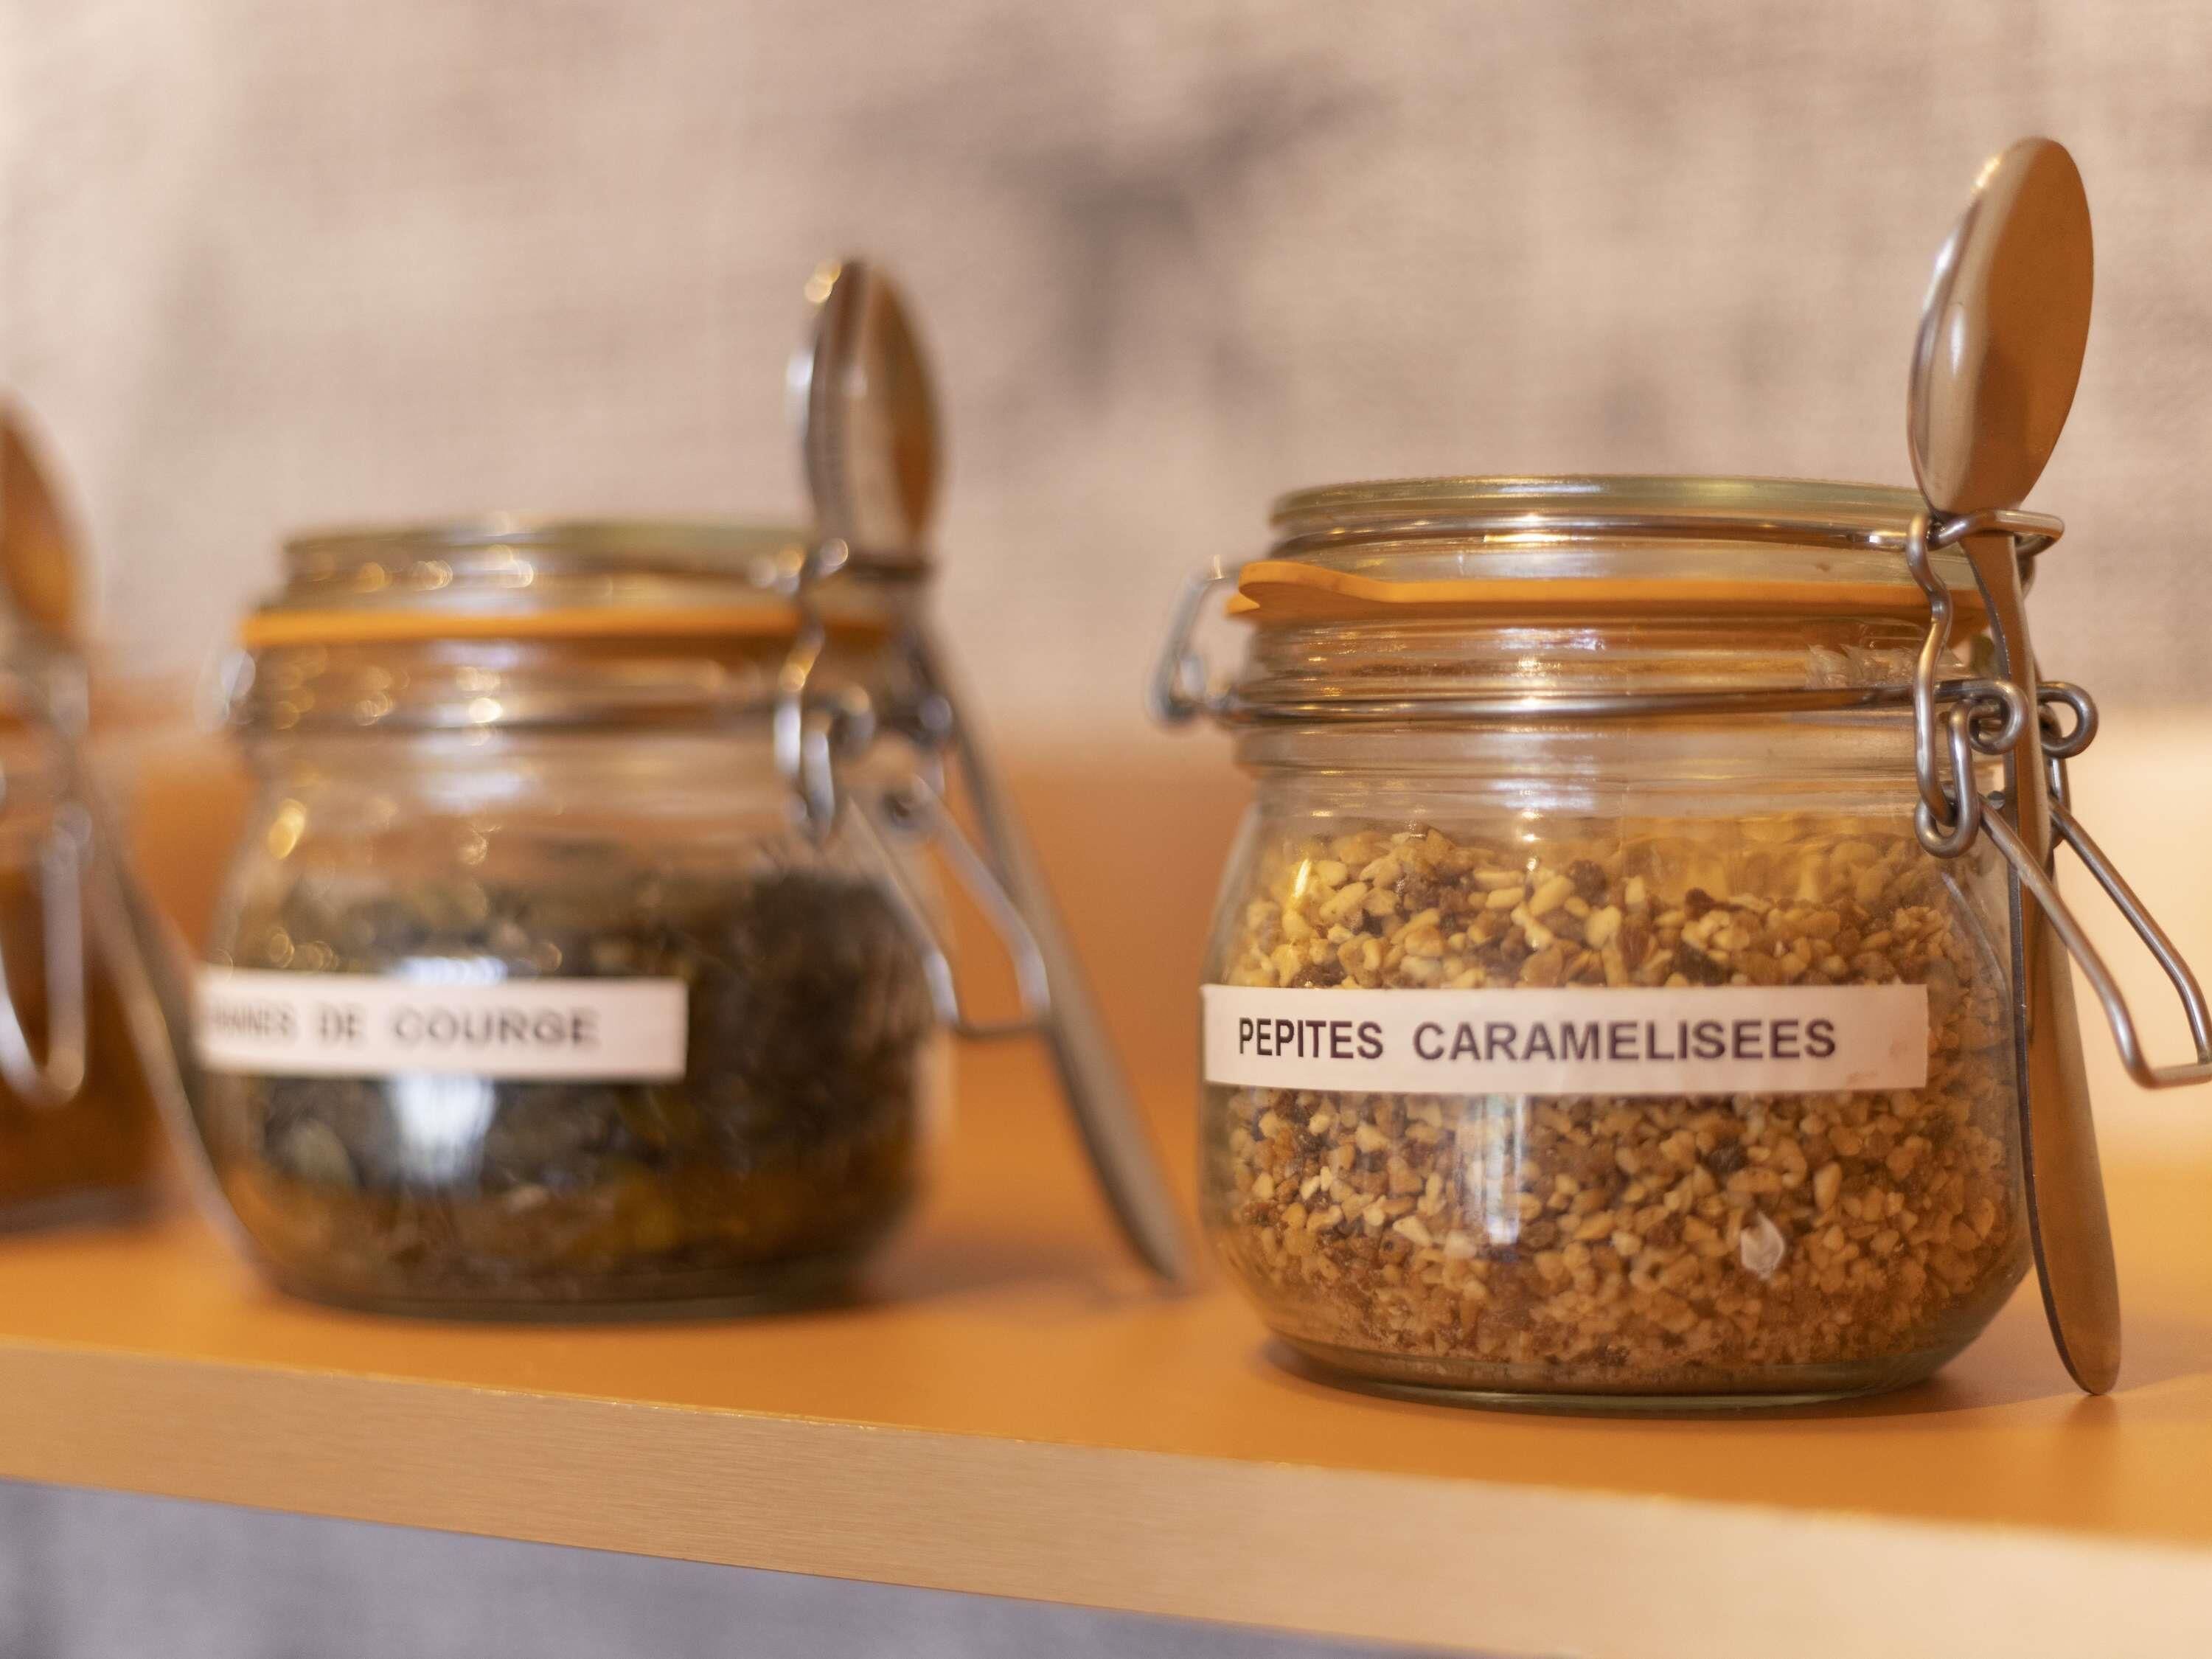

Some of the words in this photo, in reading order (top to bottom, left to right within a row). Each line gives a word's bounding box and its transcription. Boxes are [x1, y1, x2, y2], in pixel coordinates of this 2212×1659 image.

[318, 1004, 362, 1043] DE
[392, 1006, 600, 1047] COURGE
[1239, 1017, 1384, 1060] PEPITES
[1413, 1018, 1837, 1062] CARAMELISEES
